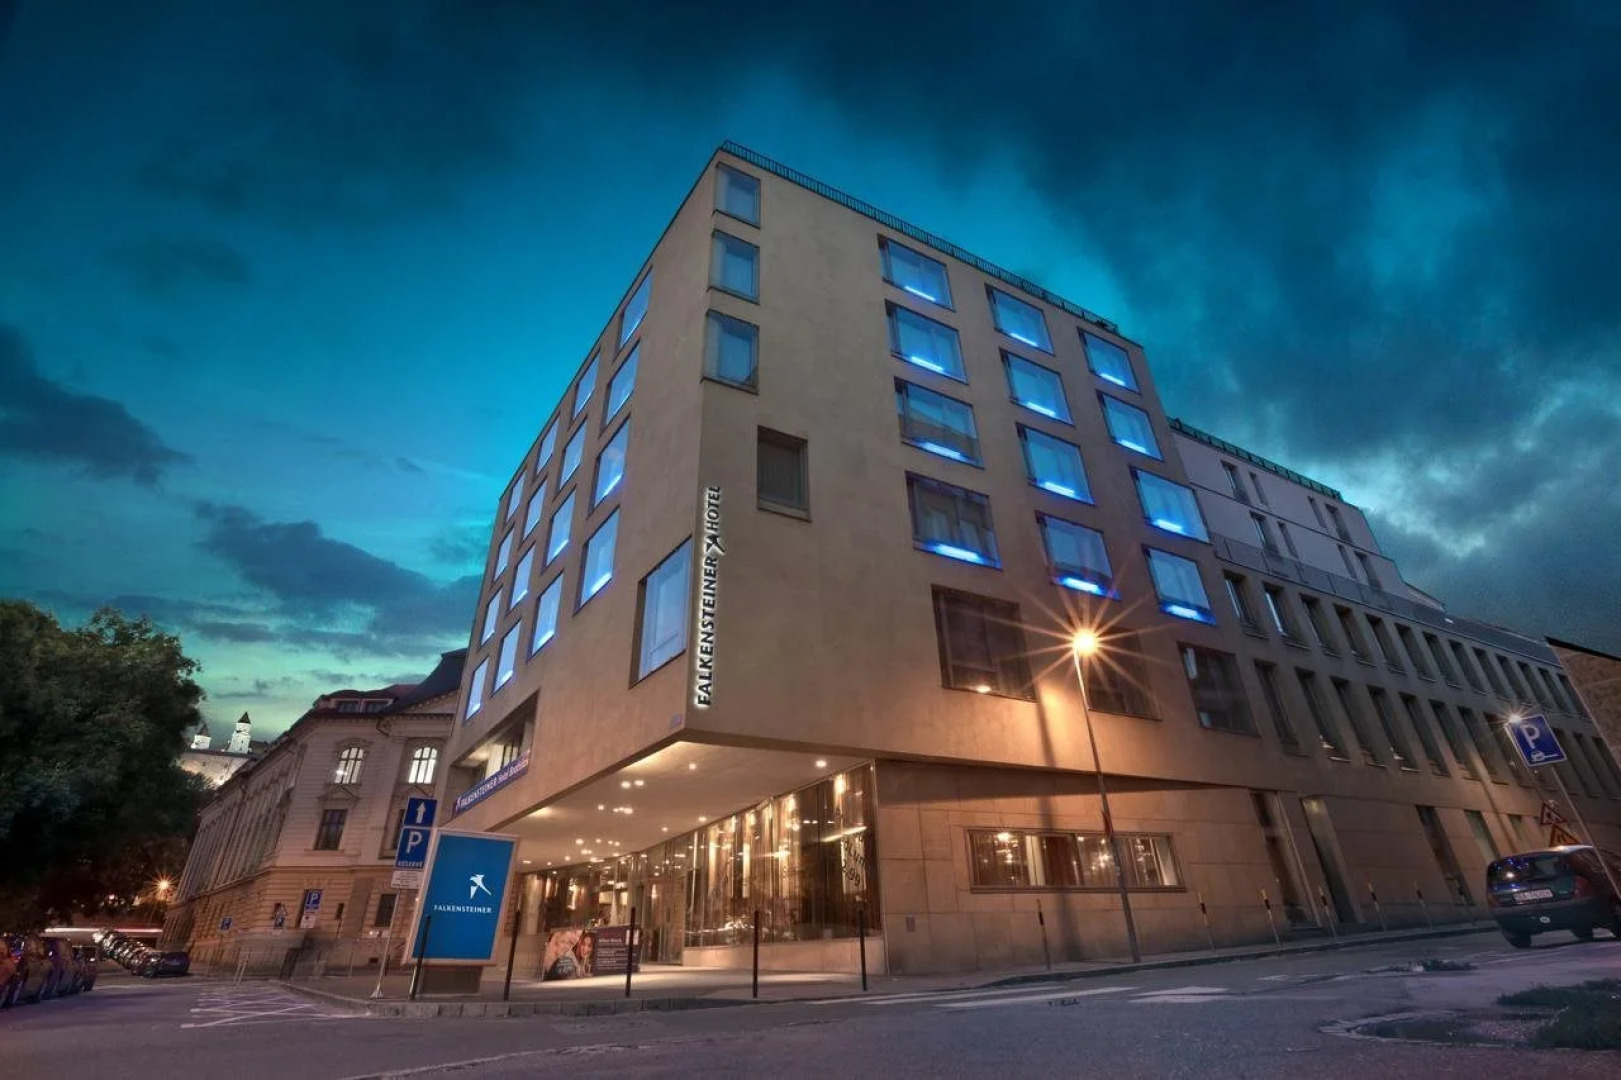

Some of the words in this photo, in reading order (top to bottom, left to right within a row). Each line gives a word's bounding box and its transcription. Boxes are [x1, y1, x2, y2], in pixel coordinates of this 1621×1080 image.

[706, 485, 721, 533] HOTEL
[696, 555, 718, 706] FALKENSTEINER
[1521, 725, 1540, 749] P
[406, 832, 422, 853] P
[434, 904, 492, 914] FALKENSTEINER
